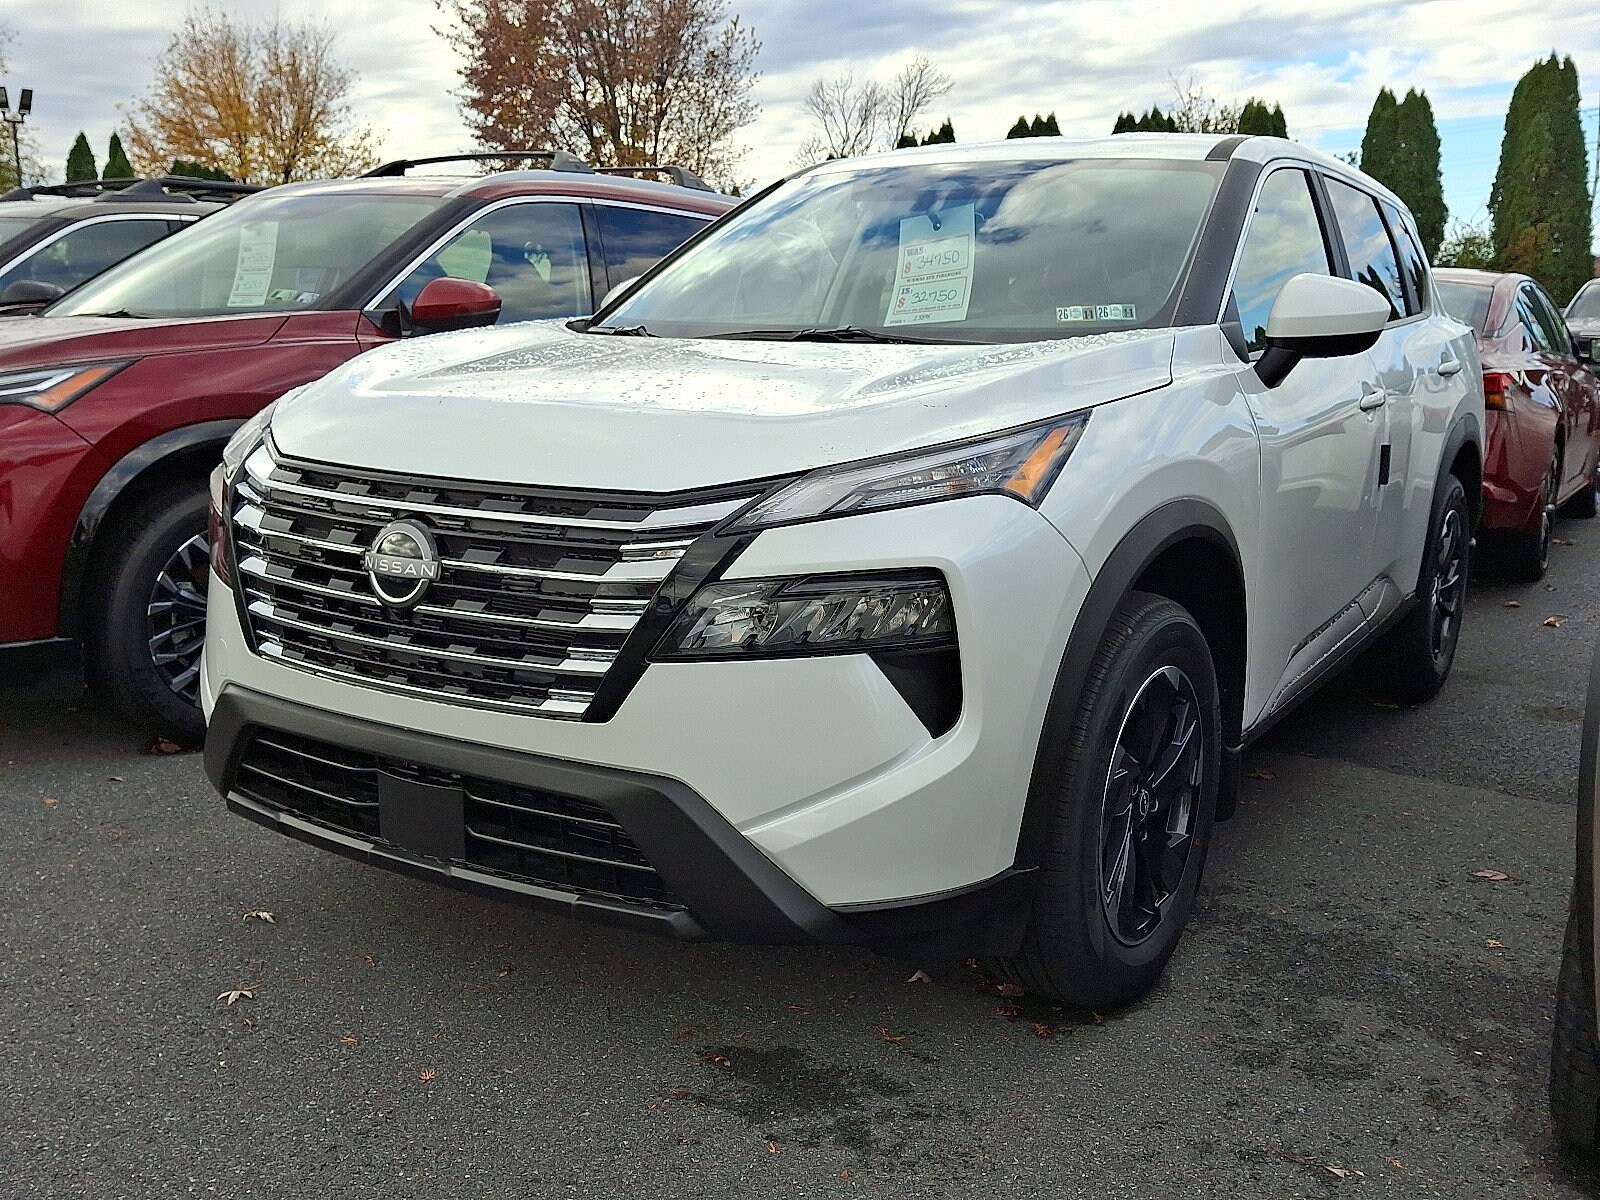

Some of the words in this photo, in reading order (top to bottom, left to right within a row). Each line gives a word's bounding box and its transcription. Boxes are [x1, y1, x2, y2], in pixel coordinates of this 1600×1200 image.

[916, 250, 960, 270] 34750
[911, 289, 958, 304] 32750
[1058, 308, 1069, 320] 26
[1098, 306, 1109, 318] 26
[364, 555, 435, 577] NISSAN
